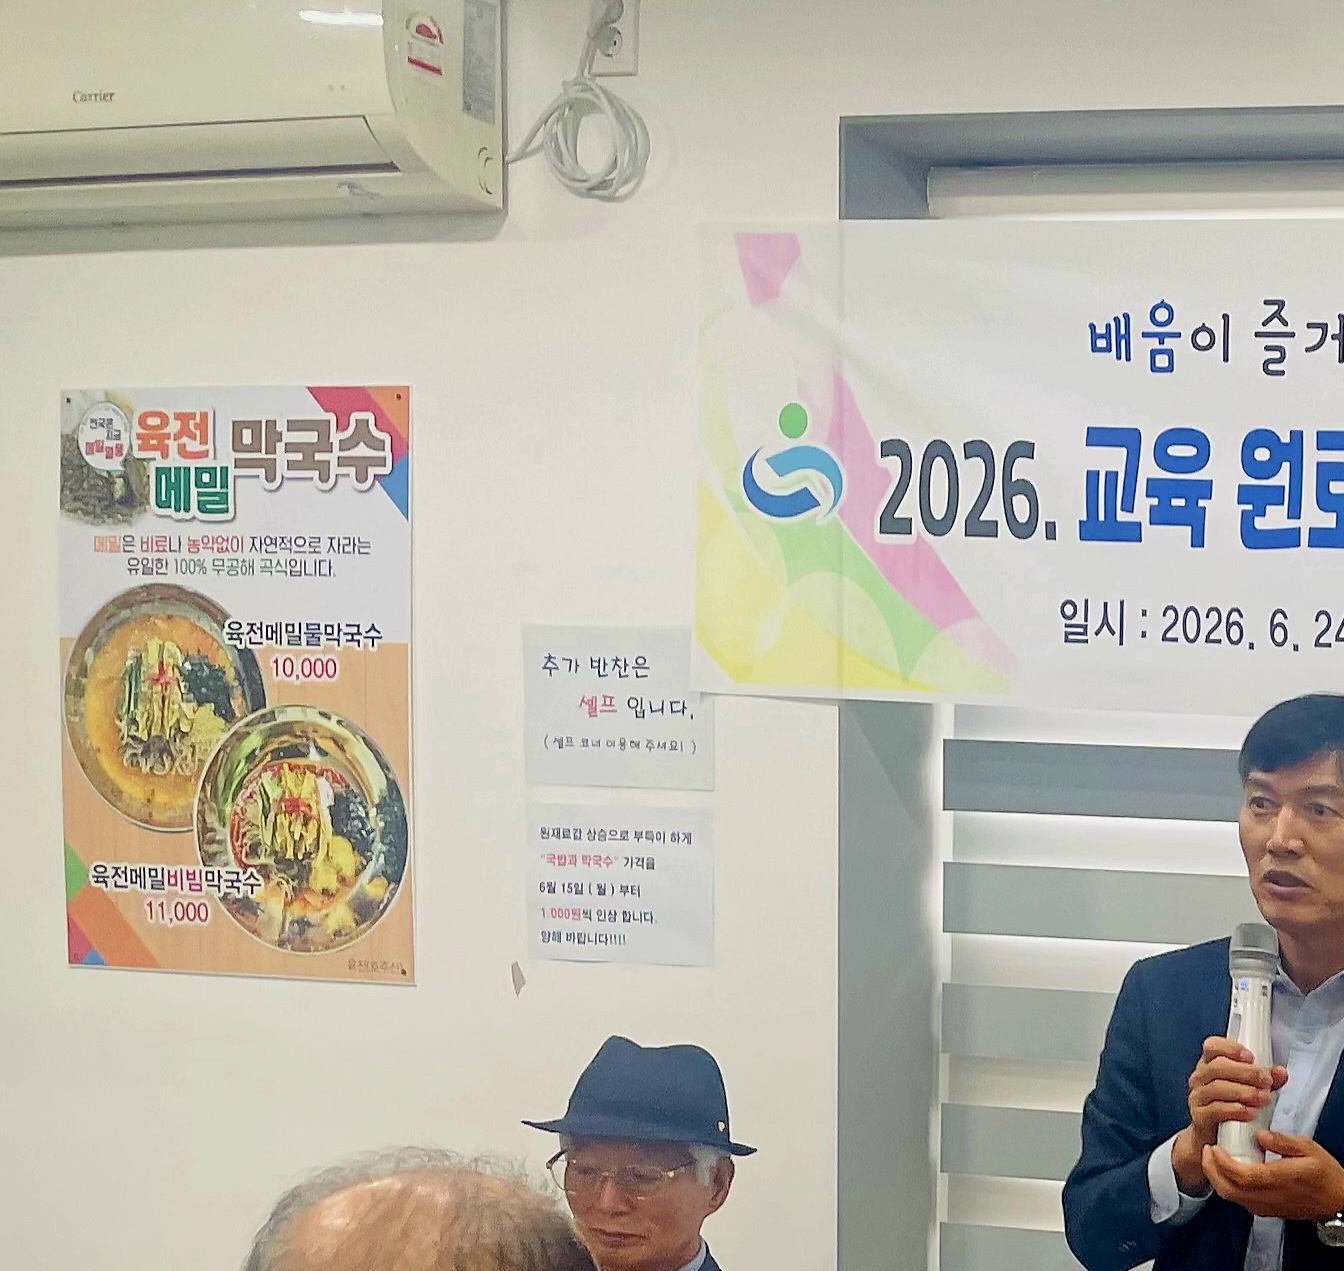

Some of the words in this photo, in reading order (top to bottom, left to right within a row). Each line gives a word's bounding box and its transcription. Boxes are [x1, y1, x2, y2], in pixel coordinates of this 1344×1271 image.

[72, 89, 115, 103] Carrier
[1089, 298, 1230, 374] 배움이
[135, 410, 209, 460] 육전
[232, 418, 388, 484] 막국수
[155, 466, 229, 514] 메밀
[877, 437, 1058, 543] 2026.
[1078, 426, 1213, 550] 교육
[140, 535, 182, 554] 비료나
[187, 535, 244, 554] 농약없이
[249, 536, 322, 555] 자연적으로
[327, 536, 372, 556] 자라는
[127, 557, 169, 576] 유일한
[174, 558, 207, 575] 100%
[212, 558, 255, 577] 무공해
[226, 621, 384, 647] 육전메밀물막국수
[1059, 599, 1127, 647] 일시
[1160, 606, 1256, 651] 2026.
[1269, 609, 1300, 652] 6.
[272, 657, 337, 681] 10,000
[542, 653, 580, 677] 추가
[590, 655, 650, 679] 반찬은
[579, 694, 618, 718] 셀프
[671, 831, 692, 845] 하게
[91, 864, 262, 895] 육전메밀비빔막국수
[539, 881, 556, 894] 6월
[562, 882, 584, 895] 15일
[619, 883, 641, 898] 부터
[145, 901, 209, 925] 11,000
[596, 909, 617, 923] 인상
